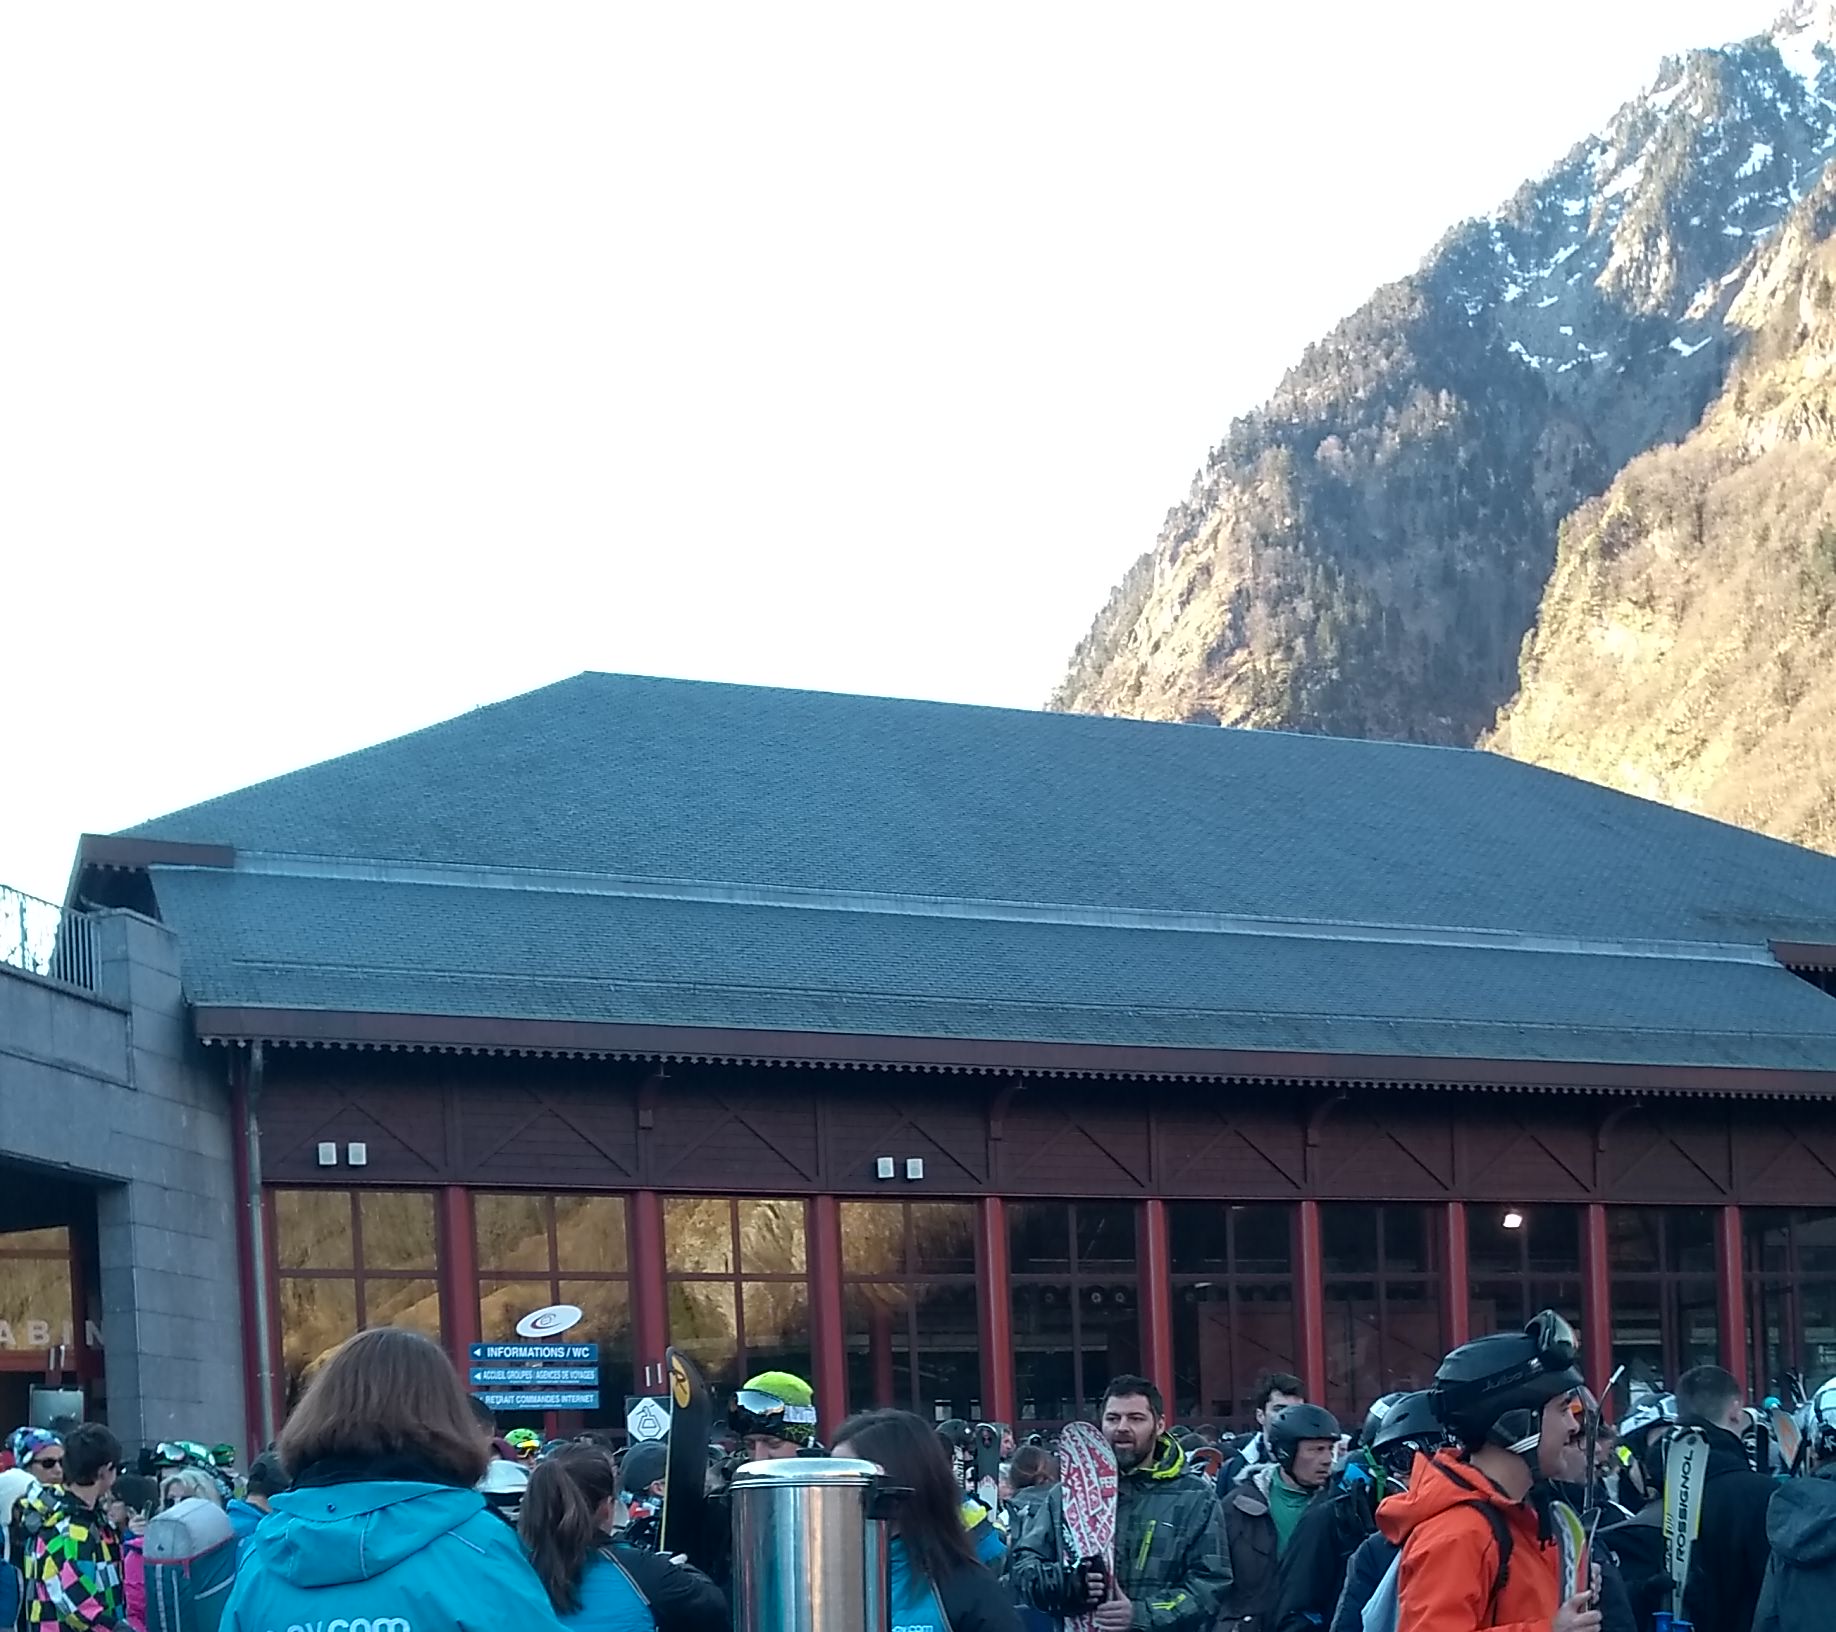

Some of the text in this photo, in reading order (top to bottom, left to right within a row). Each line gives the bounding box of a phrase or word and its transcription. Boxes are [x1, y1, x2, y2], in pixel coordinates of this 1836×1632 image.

[487, 1346, 565, 1358] INFORMATIONS
[572, 1347, 590, 1358] WC
[483, 1370, 506, 1380] ACCUEIL
[507, 1370, 532, 1380] GROUPES
[536, 1370, 560, 1380] AGENCES
[569, 1370, 595, 1380] VOYAGES
[485, 1394, 594, 1405] RETRAIT COMMANDES INTERNET
[1676, 1449, 1694, 1562] ROSSIGNOL
